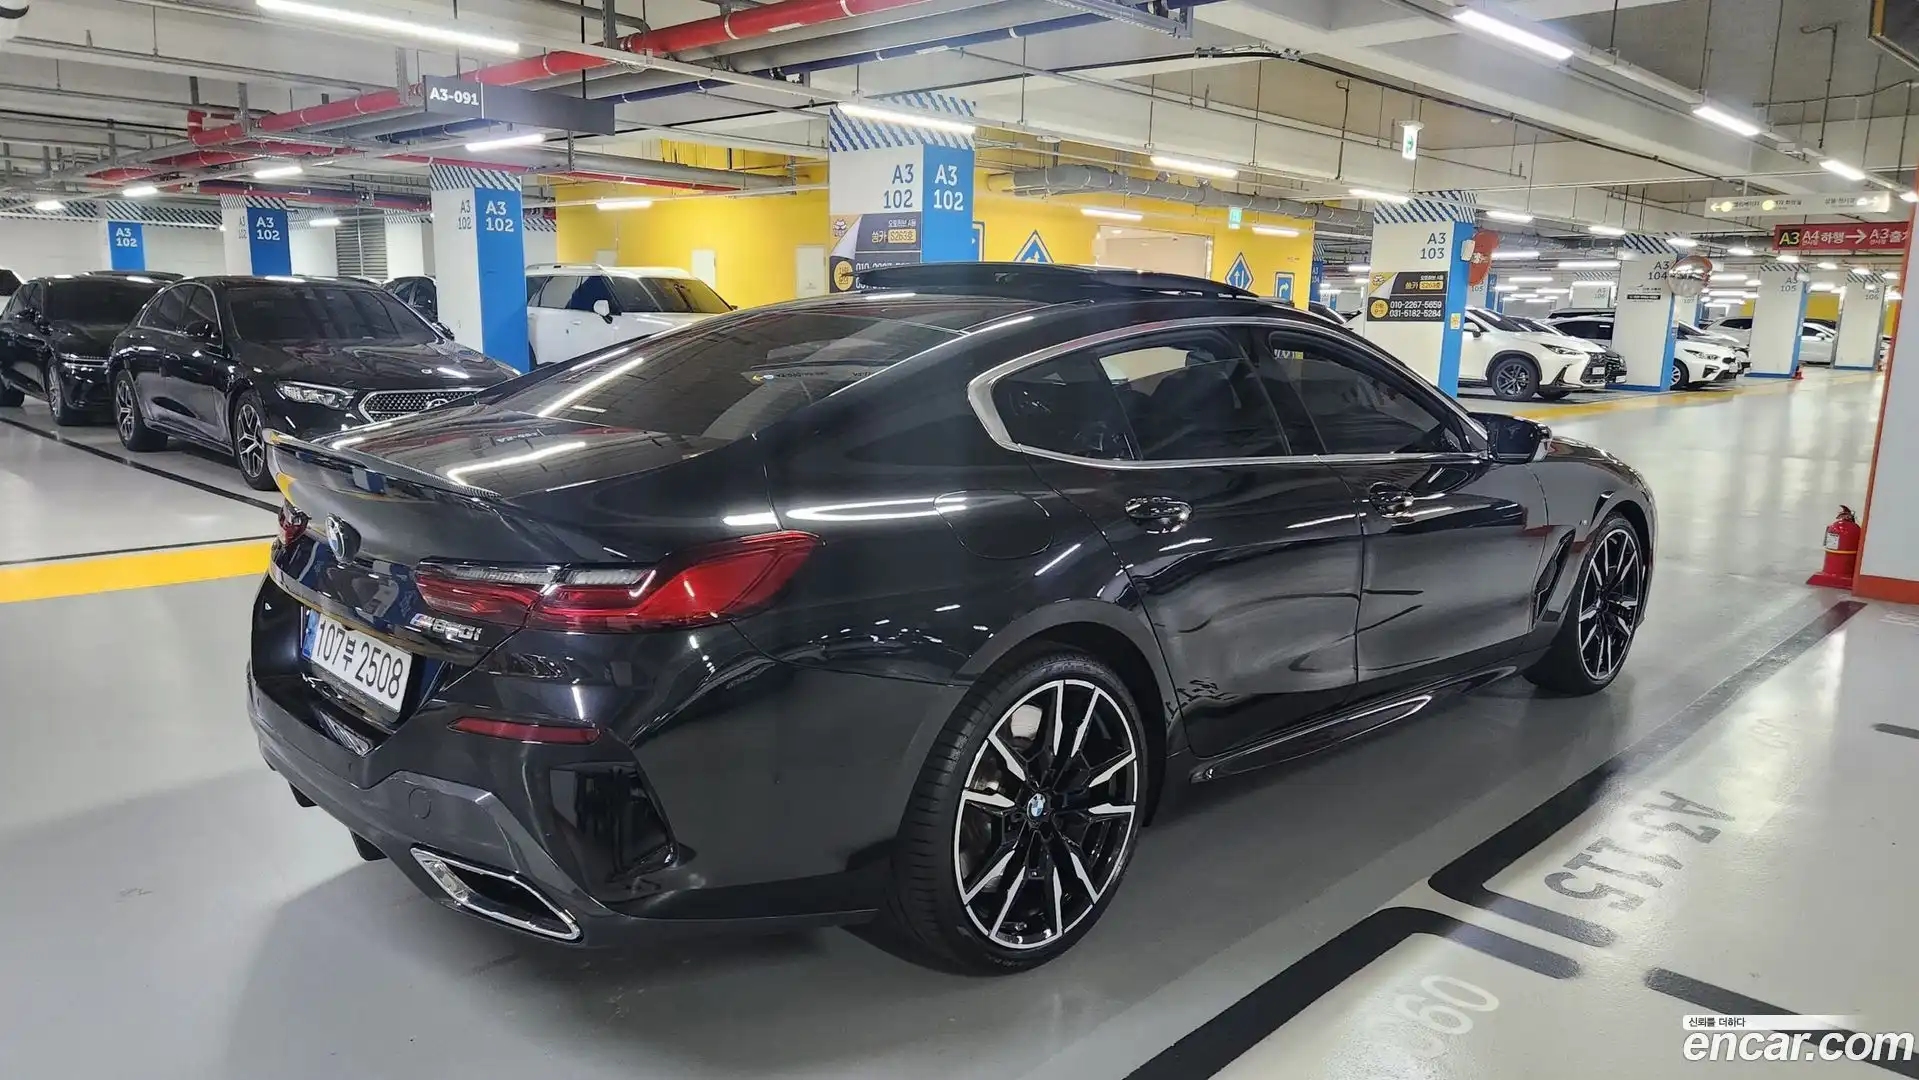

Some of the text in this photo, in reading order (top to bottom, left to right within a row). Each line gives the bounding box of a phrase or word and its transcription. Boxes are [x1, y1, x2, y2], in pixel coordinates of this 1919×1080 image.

[429, 86, 480, 106] A3-091
[892, 163, 914, 184] A3
[934, 164, 958, 186] A3
[883, 189, 913, 209] 102
[933, 189, 964, 211] 102
[460, 200, 471, 213] A3
[485, 200, 507, 215] A3
[256, 216, 274, 227] A3
[458, 216, 472, 230] 102
[486, 218, 514, 232] 102
[115, 227, 132, 237] A3
[256, 229, 280, 241] 102
[1427, 232, 1446, 244] A3
[1778, 231, 1800, 245] A3
[1802, 230, 1820, 241] A4
[1821, 231, 1845, 244] 하행
[1869, 228, 1889, 239] A3
[115, 238, 138, 247] 102
[1420, 248, 1445, 259] 103
[1654, 261, 1670, 270] A3
[1648, 271, 1668, 280] 104
[1389, 309, 1441, 317] 031-5182-5284
[316, 620, 404, 699] 107부 2508
